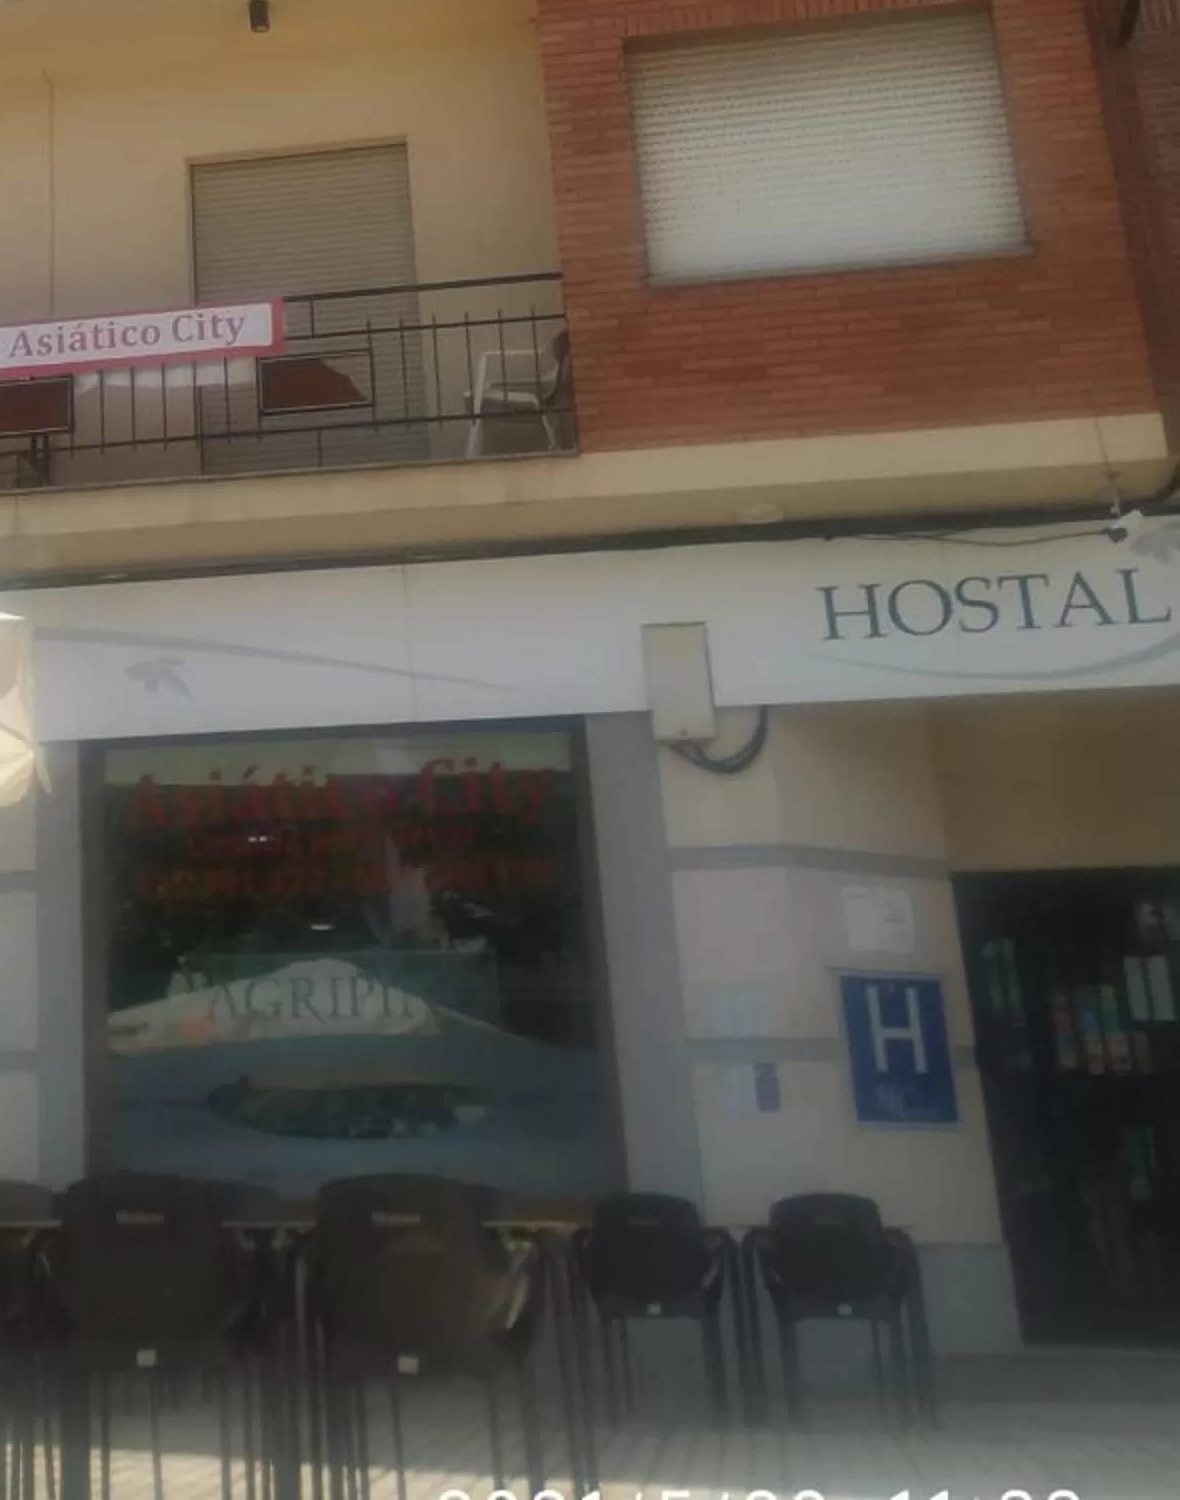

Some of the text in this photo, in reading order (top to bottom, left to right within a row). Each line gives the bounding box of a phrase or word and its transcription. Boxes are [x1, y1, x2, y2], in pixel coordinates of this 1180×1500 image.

[10, 320, 162, 358] Asiático
[172, 311, 247, 348] City
[815, 567, 1172, 641] HOSTAL
[864, 984, 929, 1075] H
